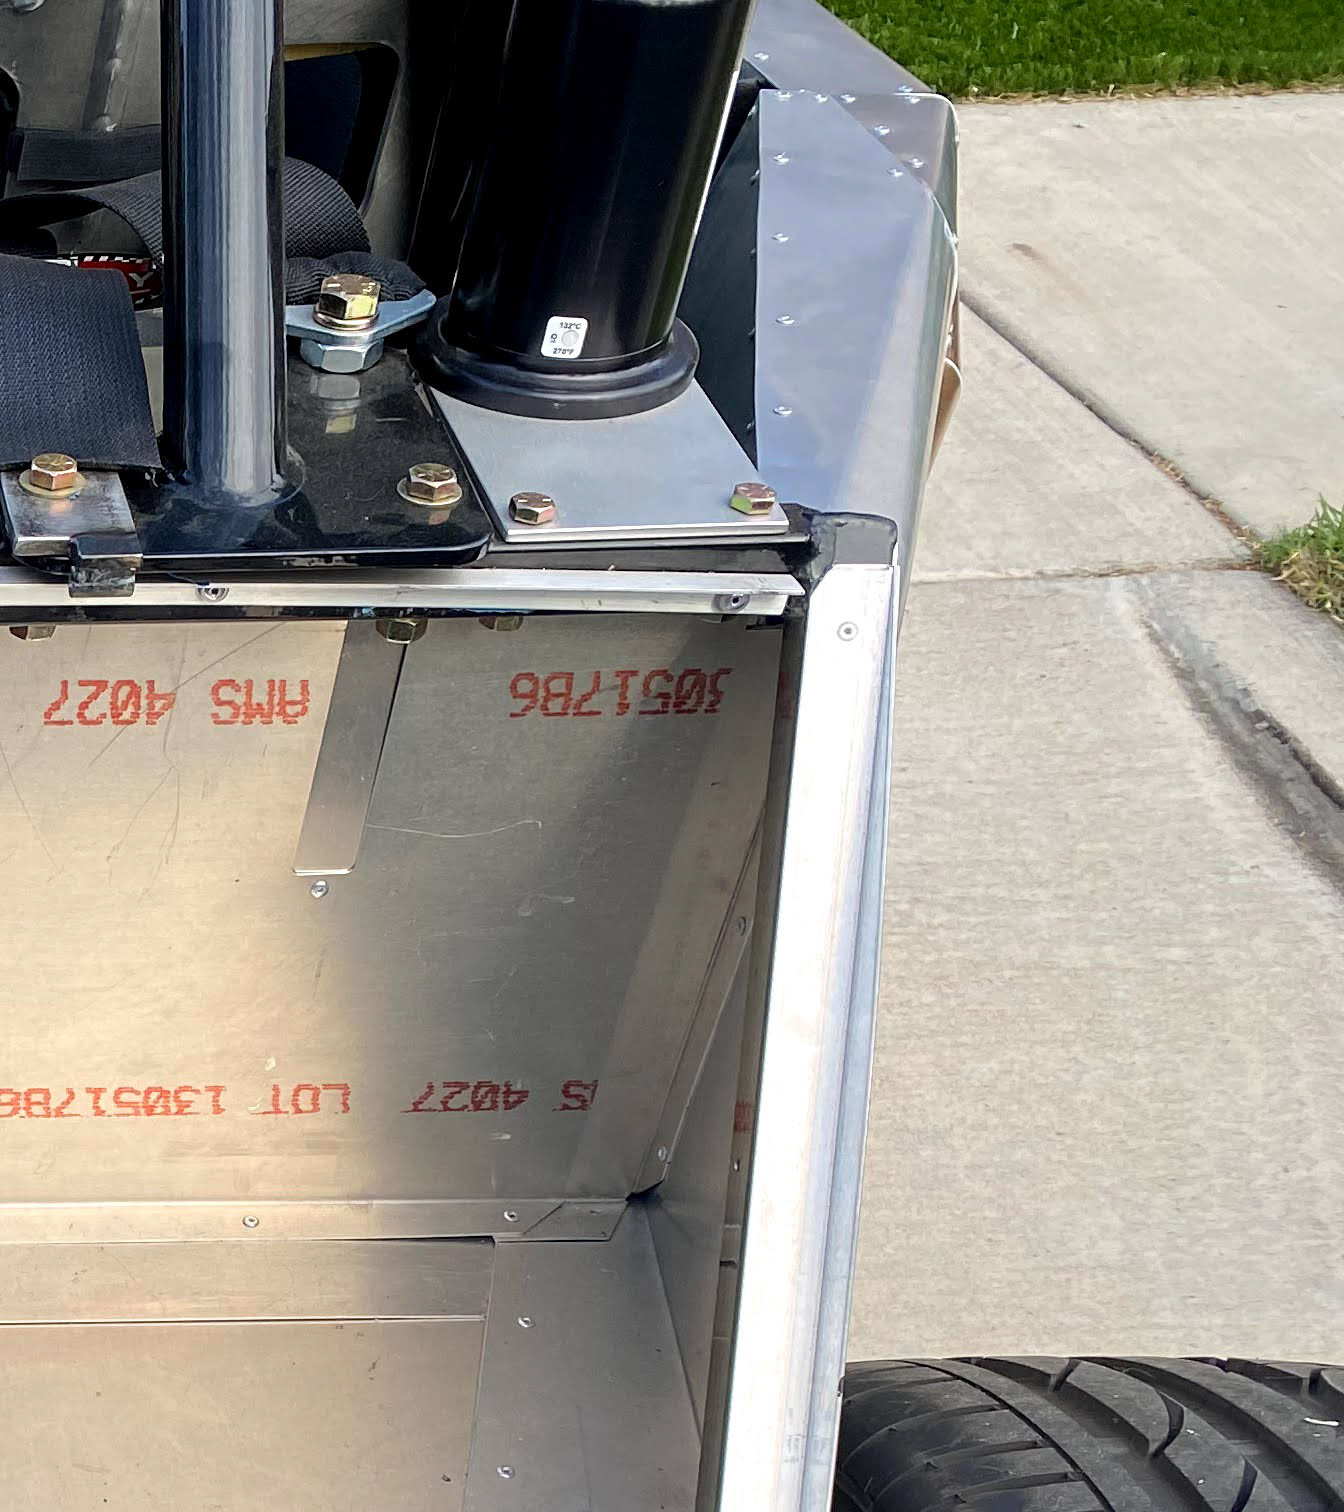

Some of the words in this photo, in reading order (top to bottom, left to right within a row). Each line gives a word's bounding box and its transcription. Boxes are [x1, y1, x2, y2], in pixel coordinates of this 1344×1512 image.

[43, 679, 178, 727] 4027
[210, 679, 311, 726] AMS
[252, 1083, 352, 1117] LOT
[402, 1079, 529, 1114] 4027
